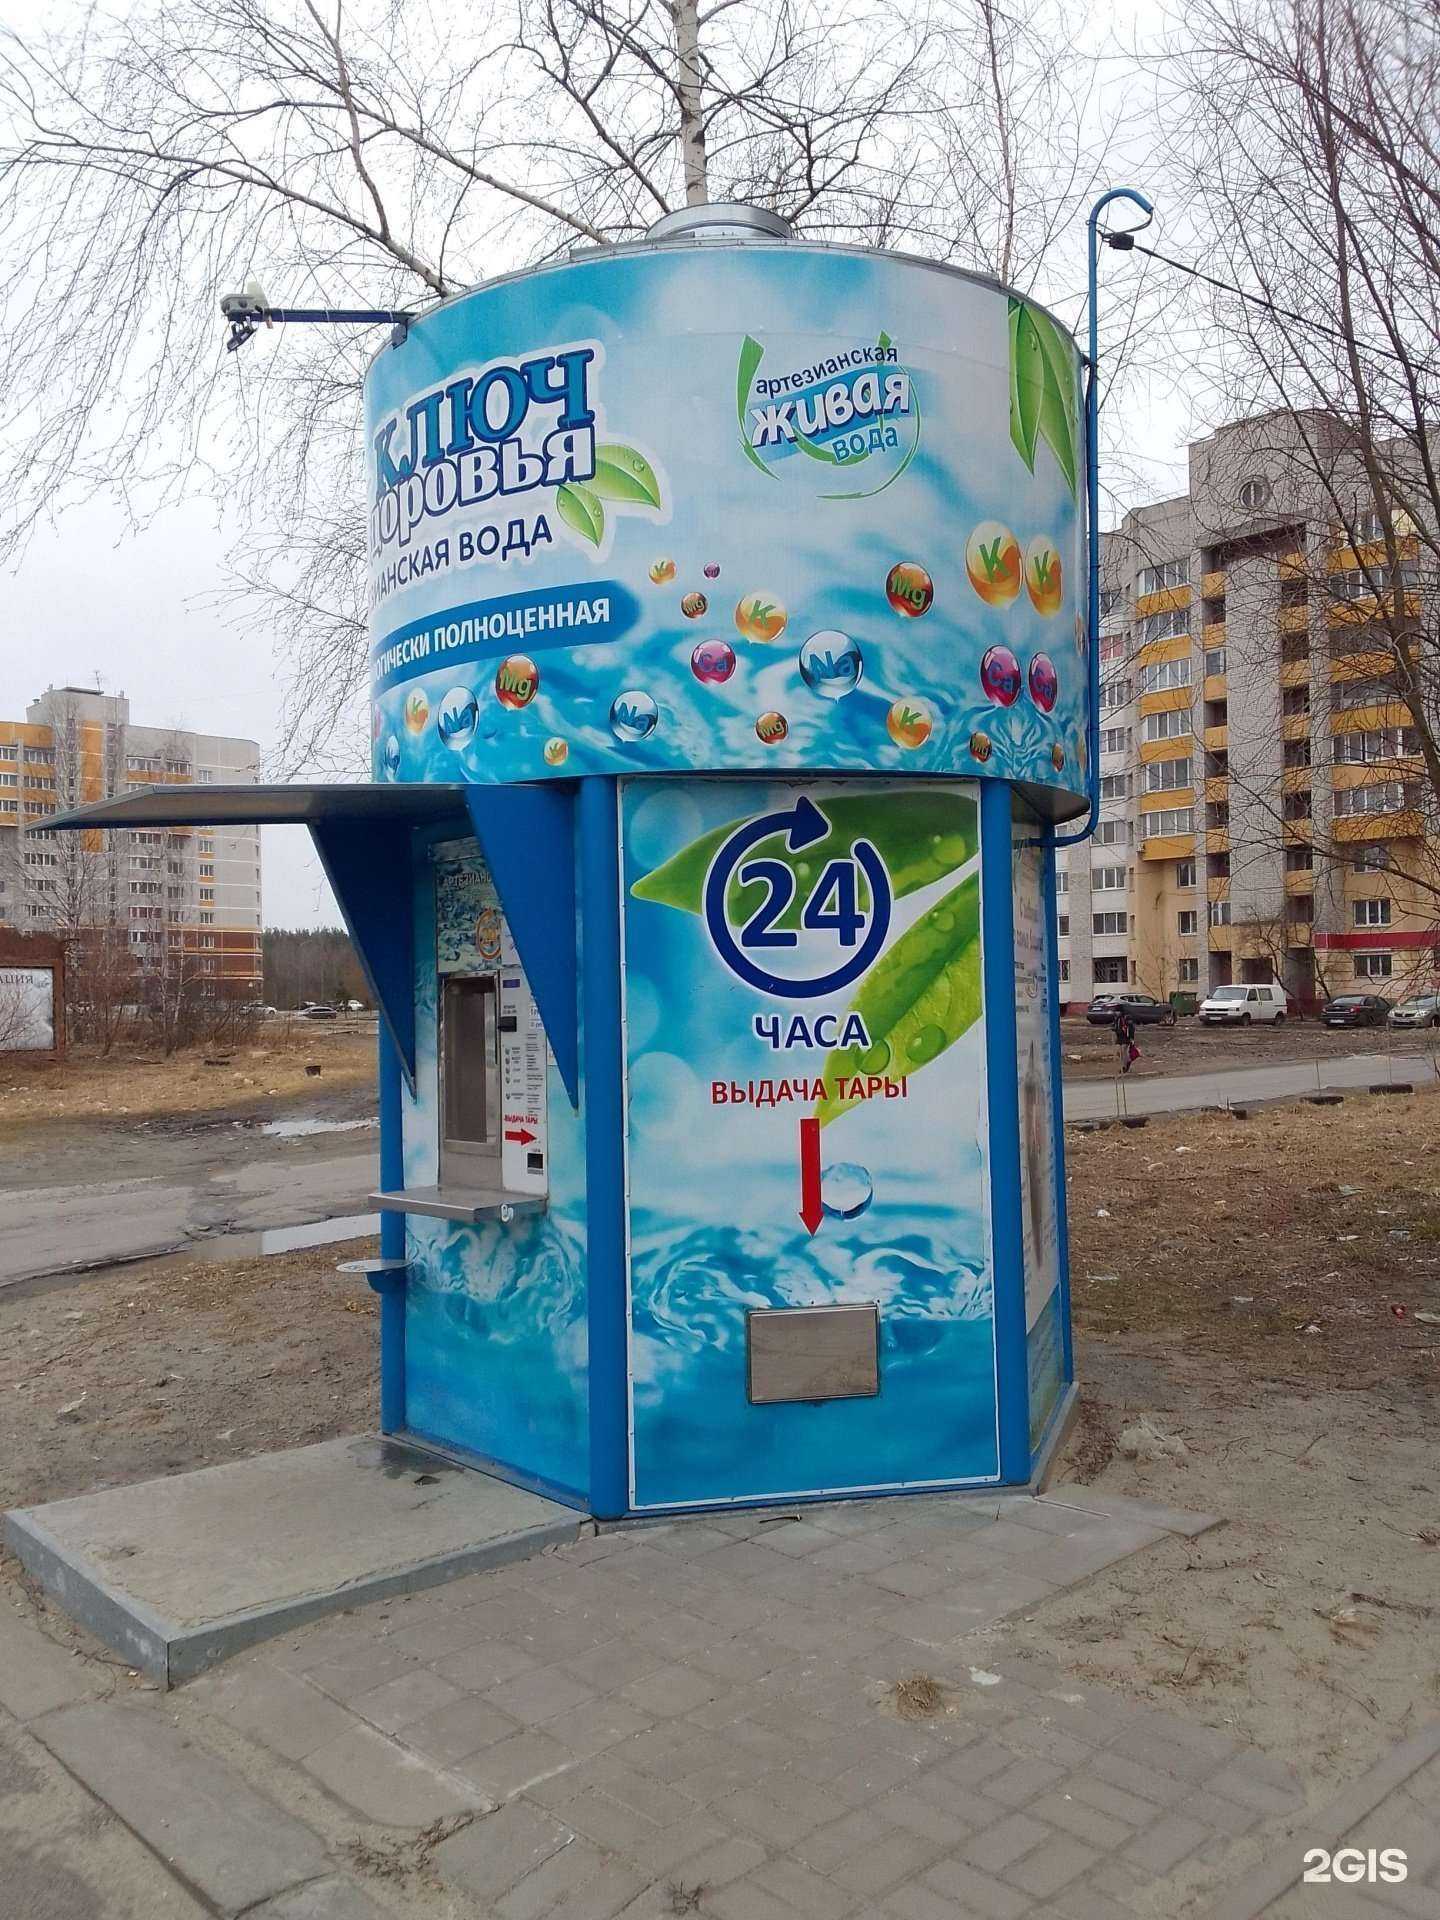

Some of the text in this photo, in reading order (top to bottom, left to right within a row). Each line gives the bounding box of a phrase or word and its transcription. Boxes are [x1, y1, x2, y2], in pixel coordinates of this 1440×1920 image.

[755, 346, 898, 398] артезианская
[374, 349, 595, 502] КЛЮЧ
[750, 372, 910, 448] живая
[459, 514, 552, 562] ВОДА
[434, 598, 611, 652] ПОЛНОЦЕННАЯ
[740, 861, 866, 947] 24
[755, 1014, 870, 1049] ЧАСА
[711, 1076, 908, 1108] ВЫДАЧА ТАРЫ
